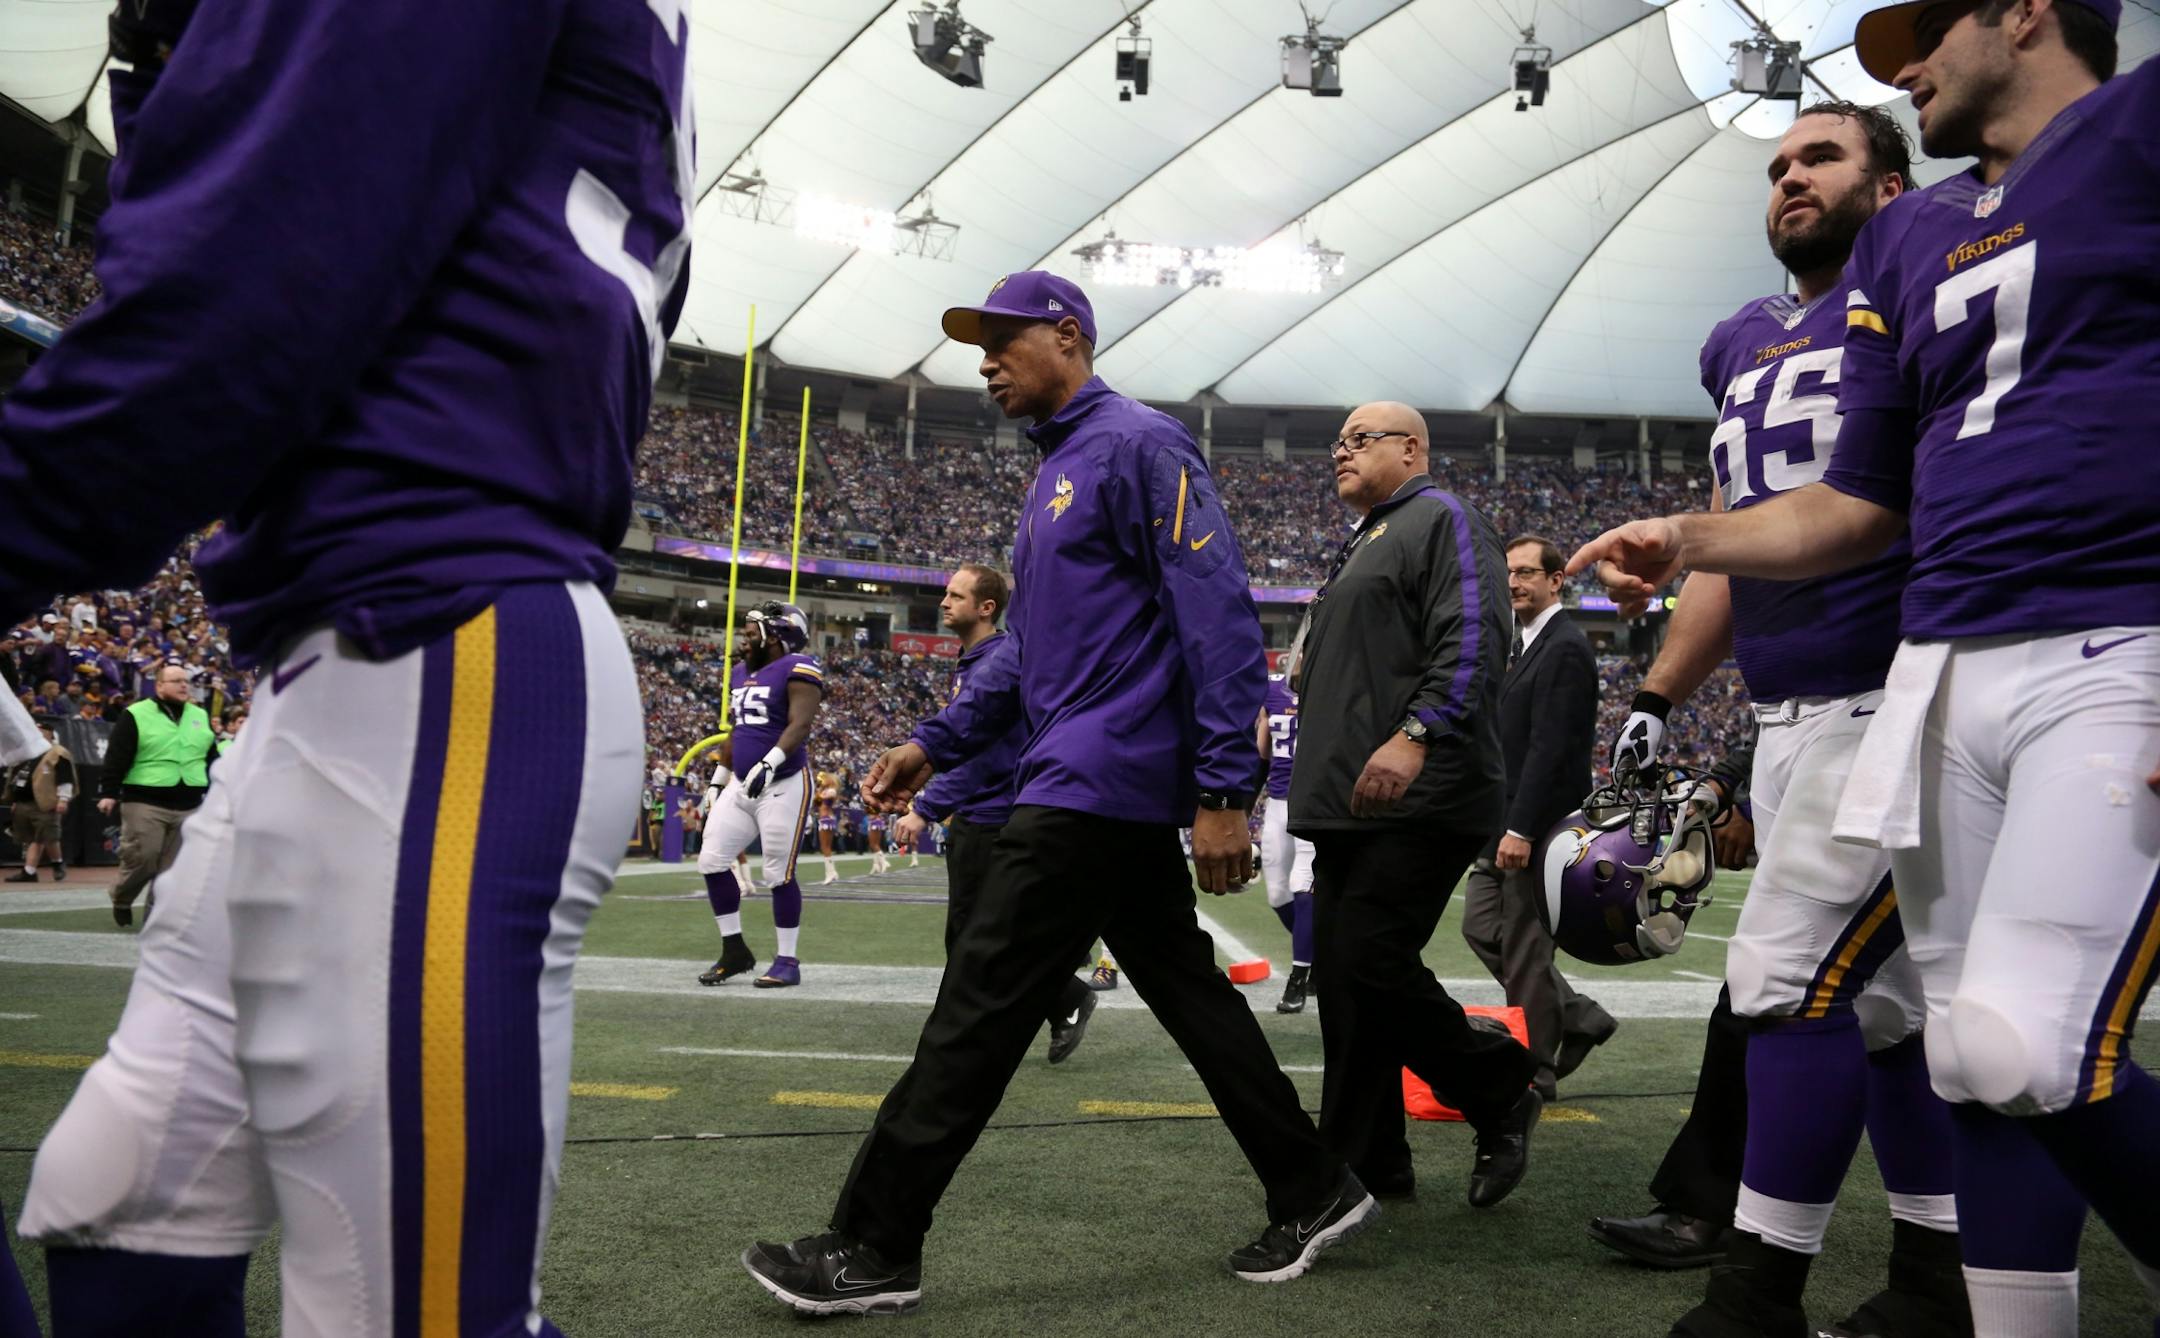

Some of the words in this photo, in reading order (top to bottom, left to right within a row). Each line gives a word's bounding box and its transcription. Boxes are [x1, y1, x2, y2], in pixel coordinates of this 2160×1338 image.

[1934, 239, 2037, 440] 7
[1709, 346, 1845, 511] 65
[1268, 714, 1298, 758] 2
